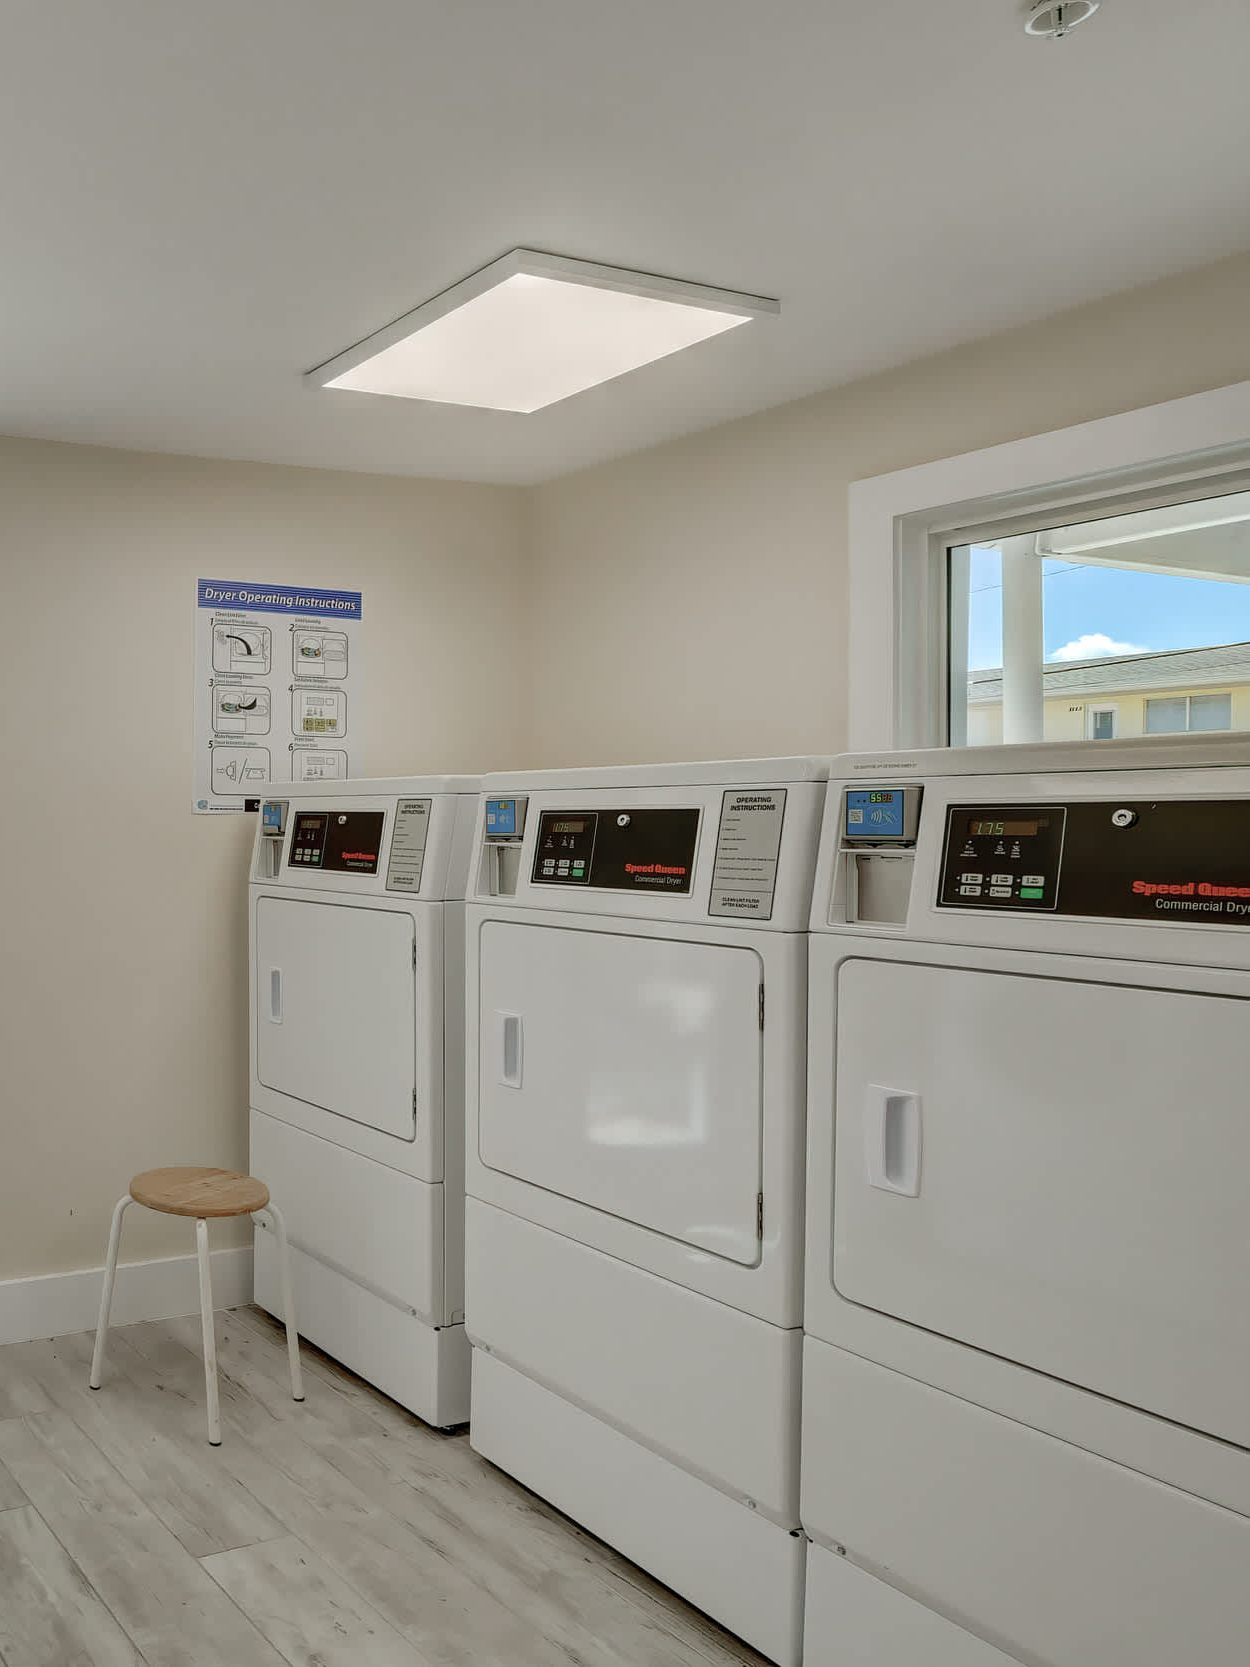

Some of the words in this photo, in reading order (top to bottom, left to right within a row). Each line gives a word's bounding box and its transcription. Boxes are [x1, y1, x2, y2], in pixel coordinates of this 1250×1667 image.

[205, 588, 237, 602] Dryer
[238, 590, 294, 608] Operating
[295, 595, 357, 611] Instructions
[288, 623, 295, 632] 2
[208, 678, 214, 687] 3
[288, 684, 294, 693] 4
[207, 740, 214, 749] 5
[288, 743, 294, 752] 6
[736, 796, 772, 804] OPERATING
[624, 863, 655, 874] Speed
[654, 863, 686, 875] Queen
[634, 874, 666, 884] Commercial
[666, 876, 683, 886] Dryer
[1132, 880, 1195, 896] Speed
[1197, 882, 1250, 898] Quee
[1155, 898, 1223, 912] Commercial
[1226, 901, 1250, 915] Dry
